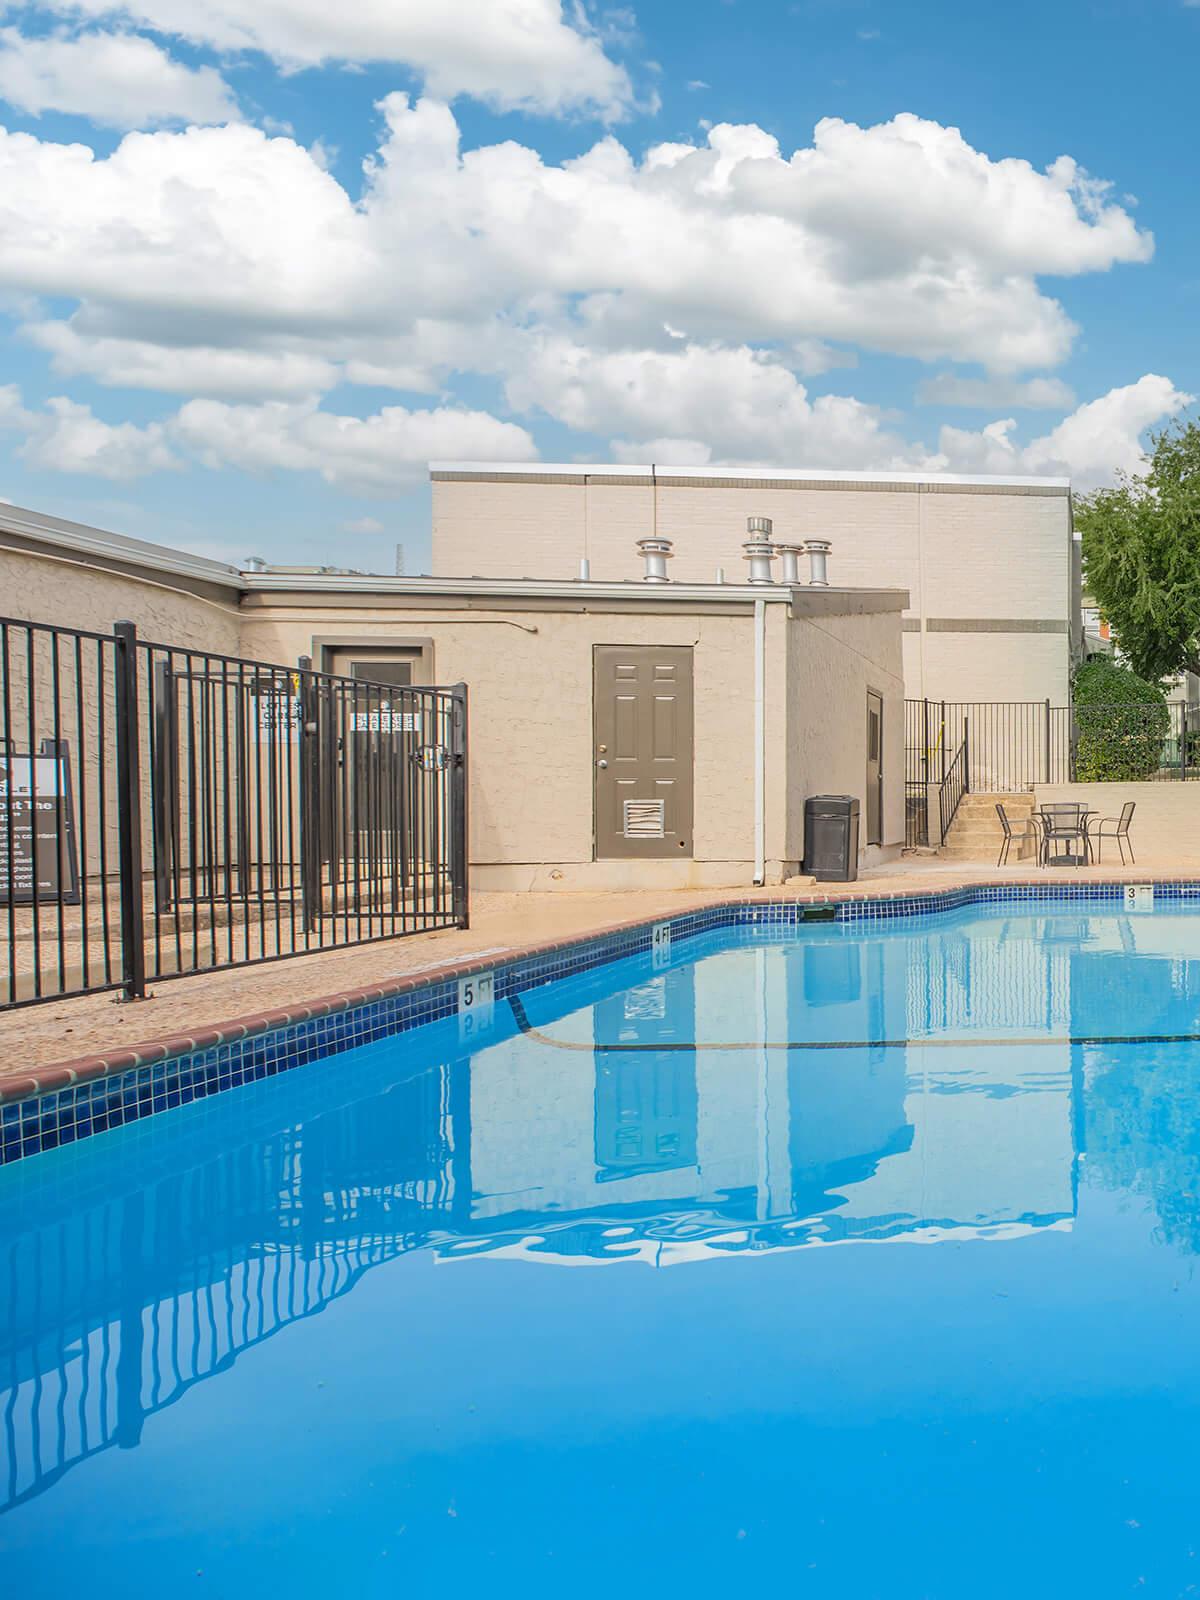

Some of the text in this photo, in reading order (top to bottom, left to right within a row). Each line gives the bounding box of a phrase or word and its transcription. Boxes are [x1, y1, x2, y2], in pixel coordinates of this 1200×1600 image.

[1128, 887, 1136, 899] 3
[655, 929, 660, 945] 4
[465, 982, 474, 1006] 5
